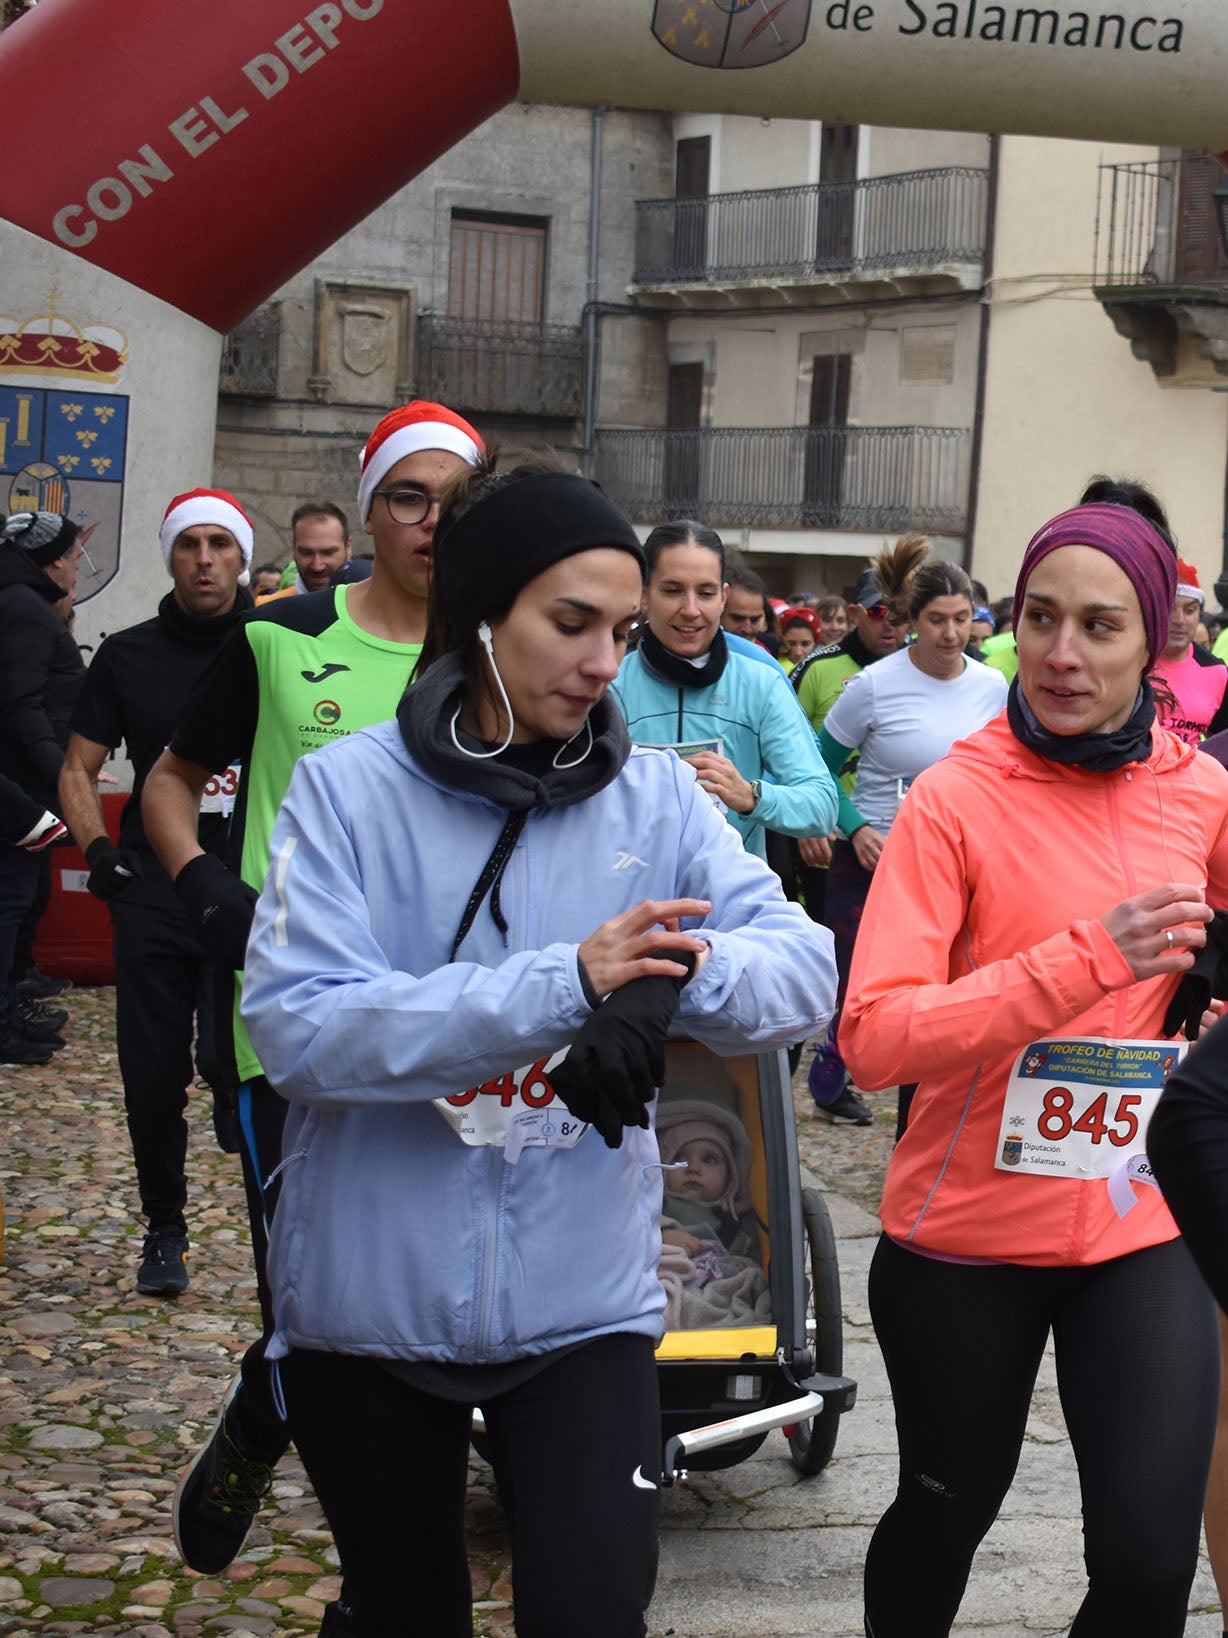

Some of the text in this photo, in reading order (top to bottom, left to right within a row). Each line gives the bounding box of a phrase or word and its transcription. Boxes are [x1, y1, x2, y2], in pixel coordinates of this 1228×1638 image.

[826, 0, 1184, 53] de Salamanca
[52, 144, 174, 248] CON
[167, 96, 249, 159] EL
[298, 725, 352, 736] CARBAJOSA
[1048, 1044, 1161, 1061] TROFEO DE NAVIDAD
[1037, 1086, 1142, 1147] 845
[1023, 1142, 1061, 1153] Diputación
[1030, 1155, 1066, 1167] Salamanca
[1137, 1163, 1156, 1177] 84
